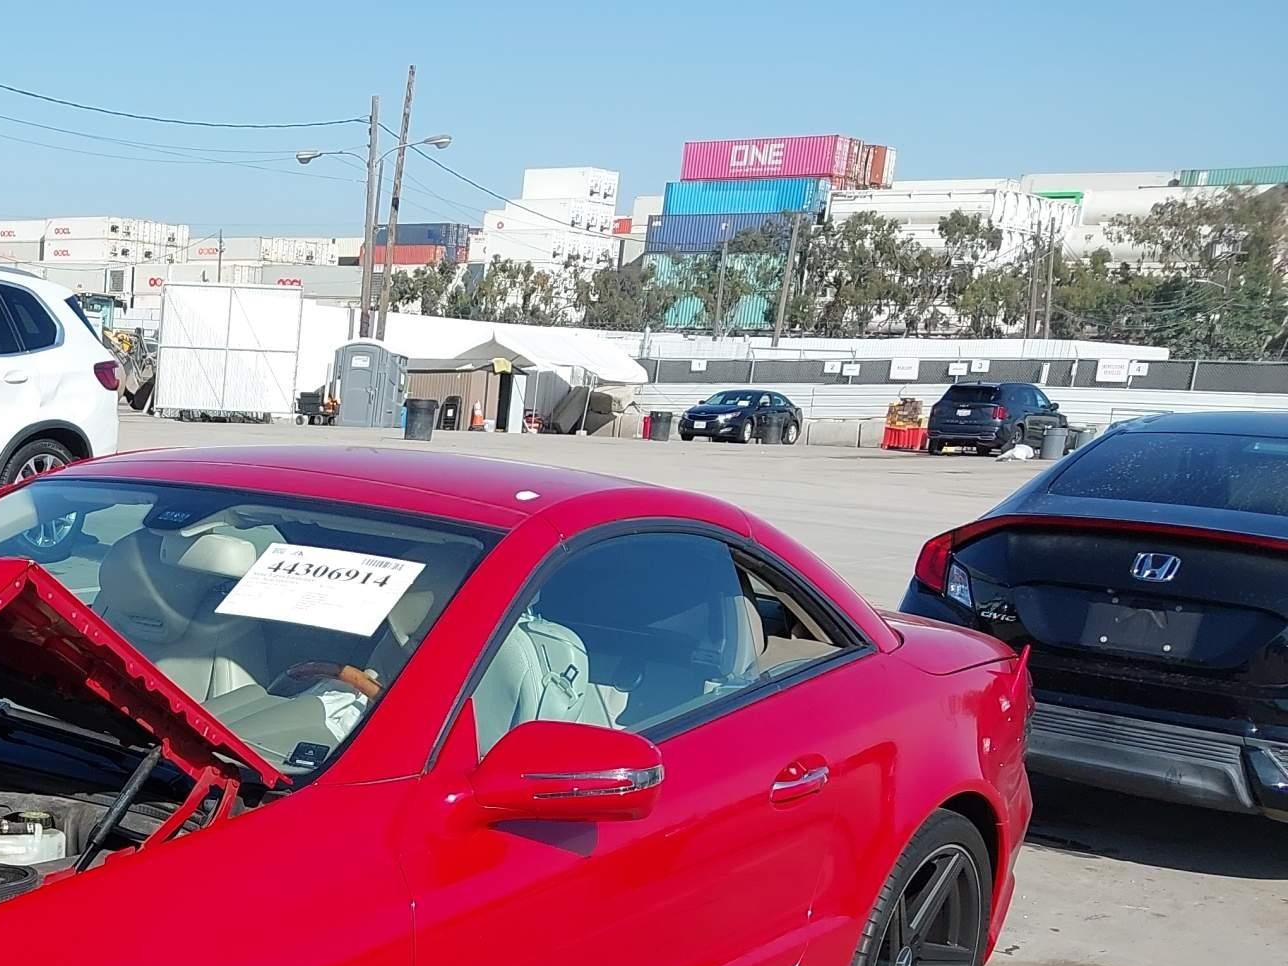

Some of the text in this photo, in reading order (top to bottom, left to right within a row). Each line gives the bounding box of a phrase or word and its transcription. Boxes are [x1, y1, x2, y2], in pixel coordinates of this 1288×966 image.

[730, 143, 784, 166] ONE
[54, 227, 71, 235] OOCL
[53, 249, 70, 257] OOCL
[267, 560, 392, 588] 44306914
